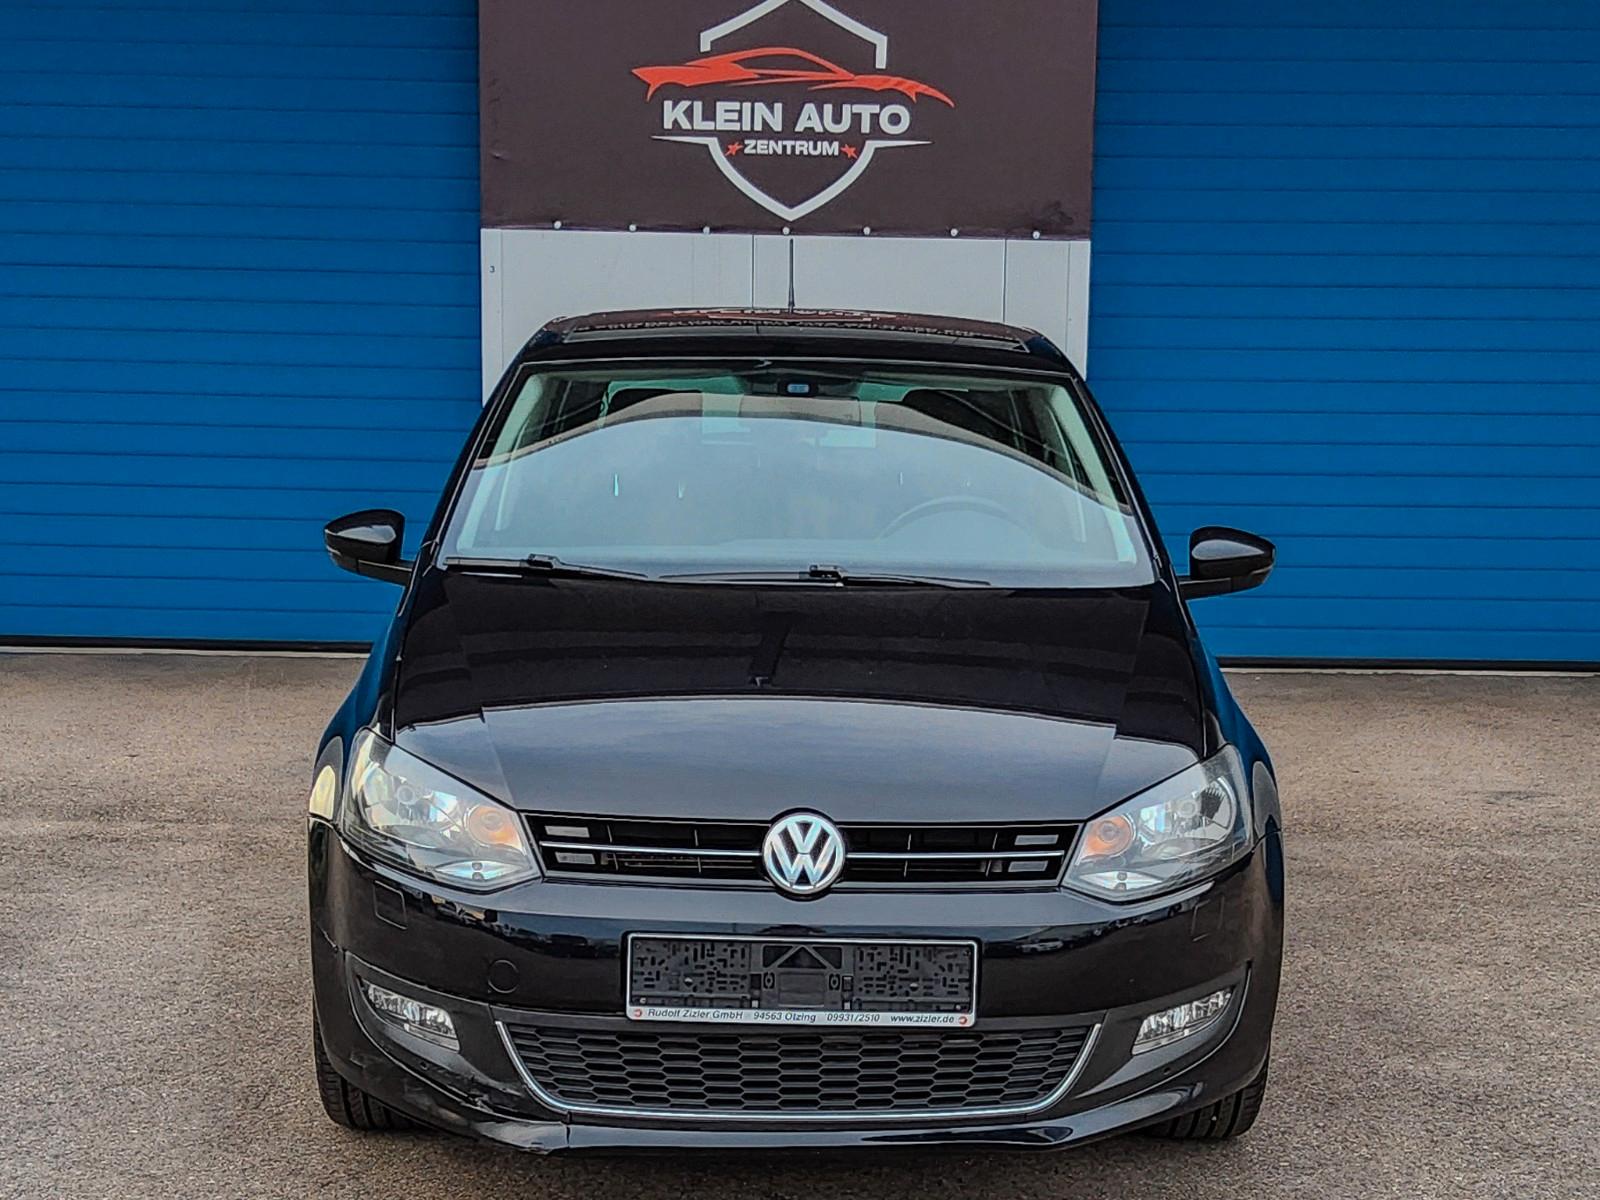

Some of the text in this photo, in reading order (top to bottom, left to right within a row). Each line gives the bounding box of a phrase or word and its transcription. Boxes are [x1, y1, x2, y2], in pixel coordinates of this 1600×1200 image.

[662, 99, 911, 135] KLEIN AUTO
[743, 139, 839, 157] ZENTRUM
[762, 812, 846, 895] VW
[647, 1008, 681, 1018] Rudolf
[682, 1009, 711, 1019] Zizler
[712, 1010, 744, 1020] GmbH
[753, 1011, 782, 1021] 94563
[826, 1013, 881, 1022] 09931/2510
[890, 1015, 955, 1024] www.zizler.de
